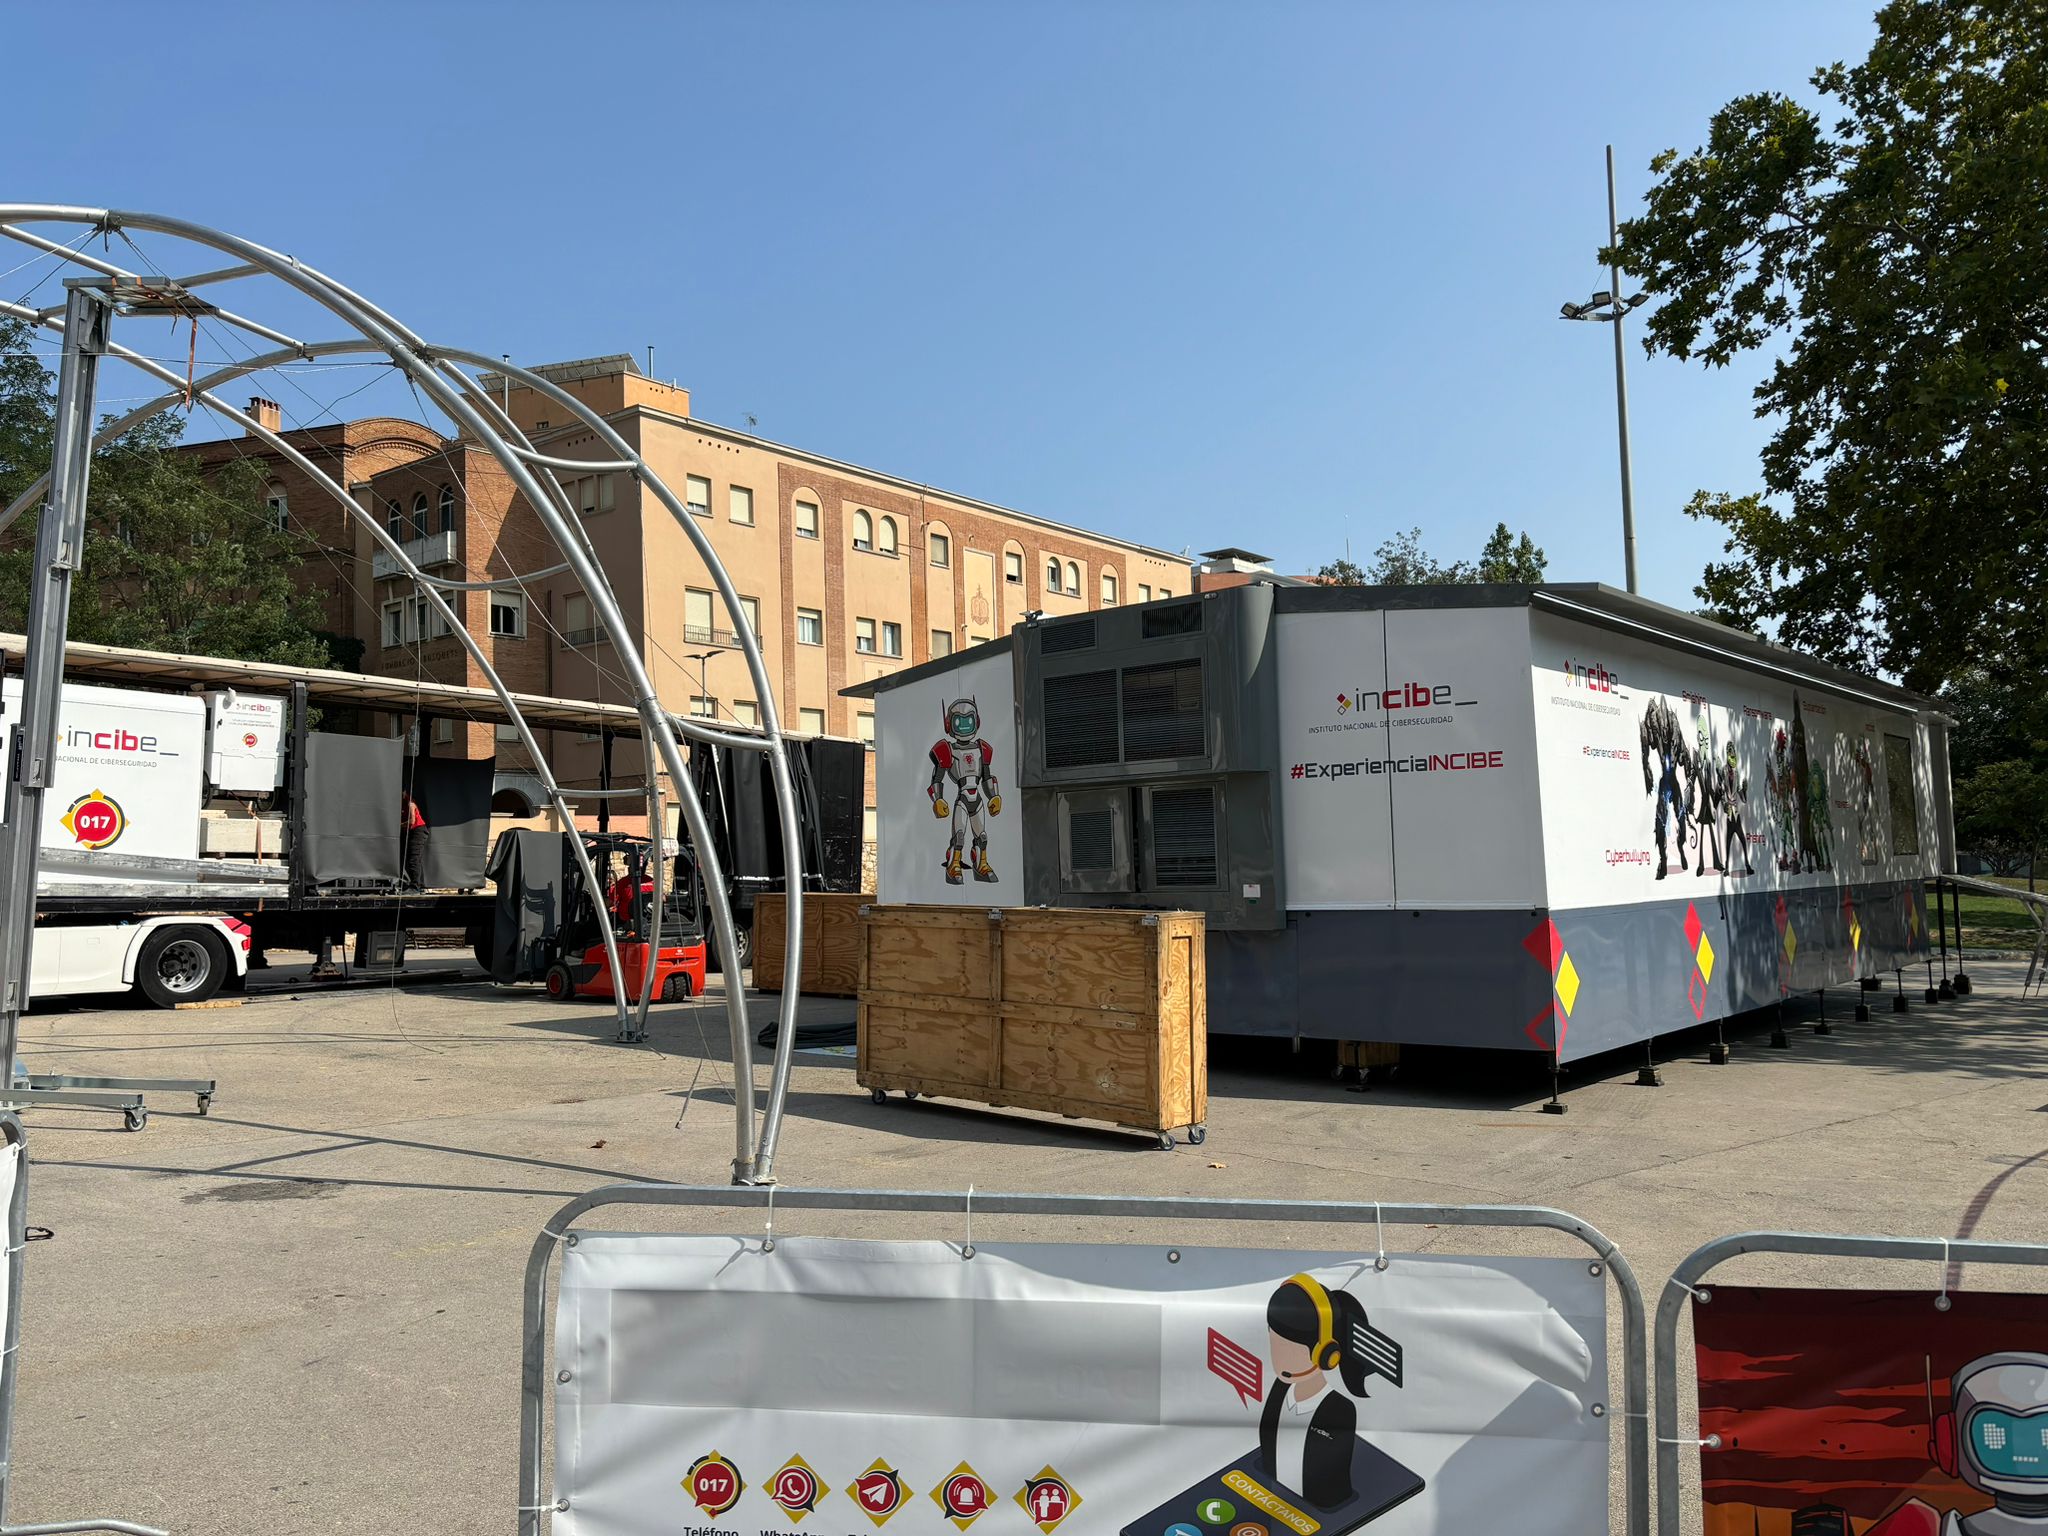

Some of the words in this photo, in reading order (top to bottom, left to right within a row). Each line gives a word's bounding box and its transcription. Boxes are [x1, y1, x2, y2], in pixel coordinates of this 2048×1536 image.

[1308, 725, 1342, 735] INSTITUTO
[1343, 722, 1378, 731] NACIONAL
[1379, 720, 1390, 728] DE
[1392, 715, 1454, 727] CIBERSEGURIDAD
[89, 757, 99, 765] DE
[100, 758, 157, 768] CIBERSEGURIDAD
[1290, 750, 1504, 781] #ExperienciaINCIBE
[80, 815, 111, 829] 017
[1605, 849, 1650, 866] Cyberbullying
[699, 1478, 728, 1492] 017
[1228, 1474, 1314, 1533] CONTÁCTANOS
